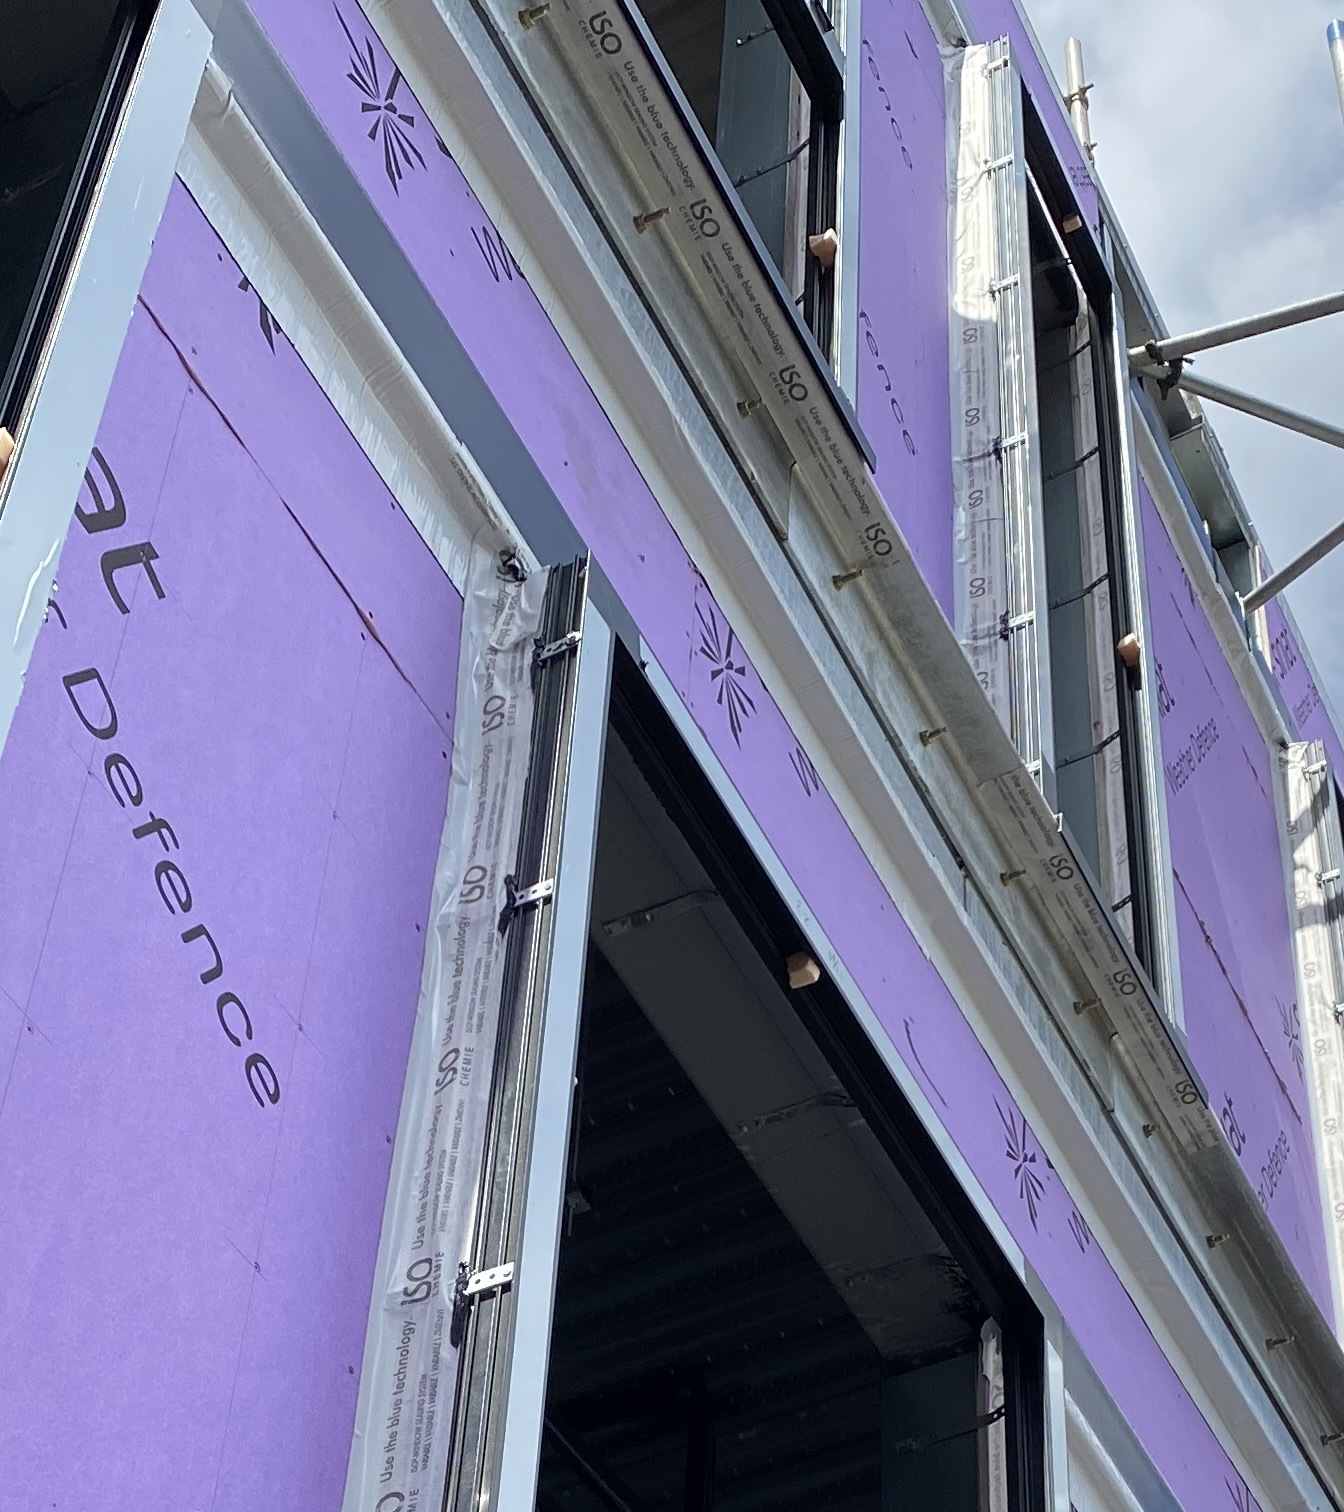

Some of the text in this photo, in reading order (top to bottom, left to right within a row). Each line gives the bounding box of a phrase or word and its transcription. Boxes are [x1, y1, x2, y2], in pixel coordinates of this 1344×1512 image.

[63, 667, 281, 1108] Defence
[387, 1397, 402, 1424] blue
[383, 1427, 398, 1450] the
[378, 1455, 394, 1482] Use
